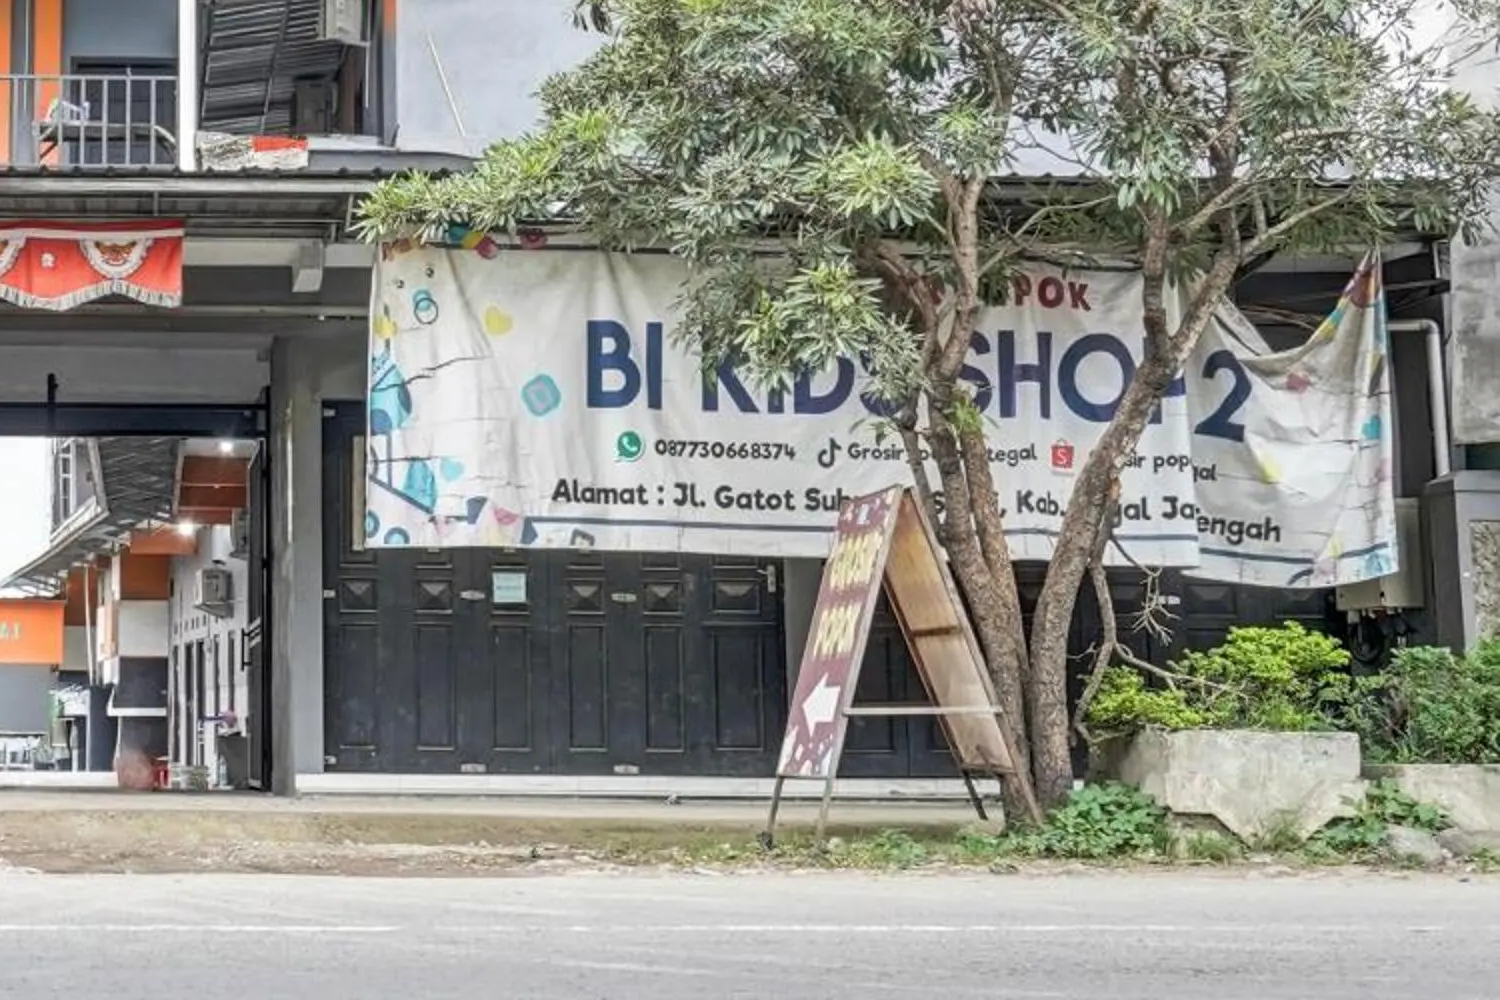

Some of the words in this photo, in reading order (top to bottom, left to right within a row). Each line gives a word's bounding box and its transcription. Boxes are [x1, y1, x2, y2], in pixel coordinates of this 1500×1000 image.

[586, 320, 663, 410] BI
[1194, 349, 1253, 443] 2
[654, 439, 797, 461] 087730668374
[1152, 454, 1192, 475] pop
[550, 477, 649, 505] Alamat
[672, 481, 706, 508] Jl.
[712, 484, 796, 511] Gatot
[1016, 489, 1066, 516] Kab.
[1161, 495, 1200, 520] Ja
[1196, 513, 1283, 545] engah
